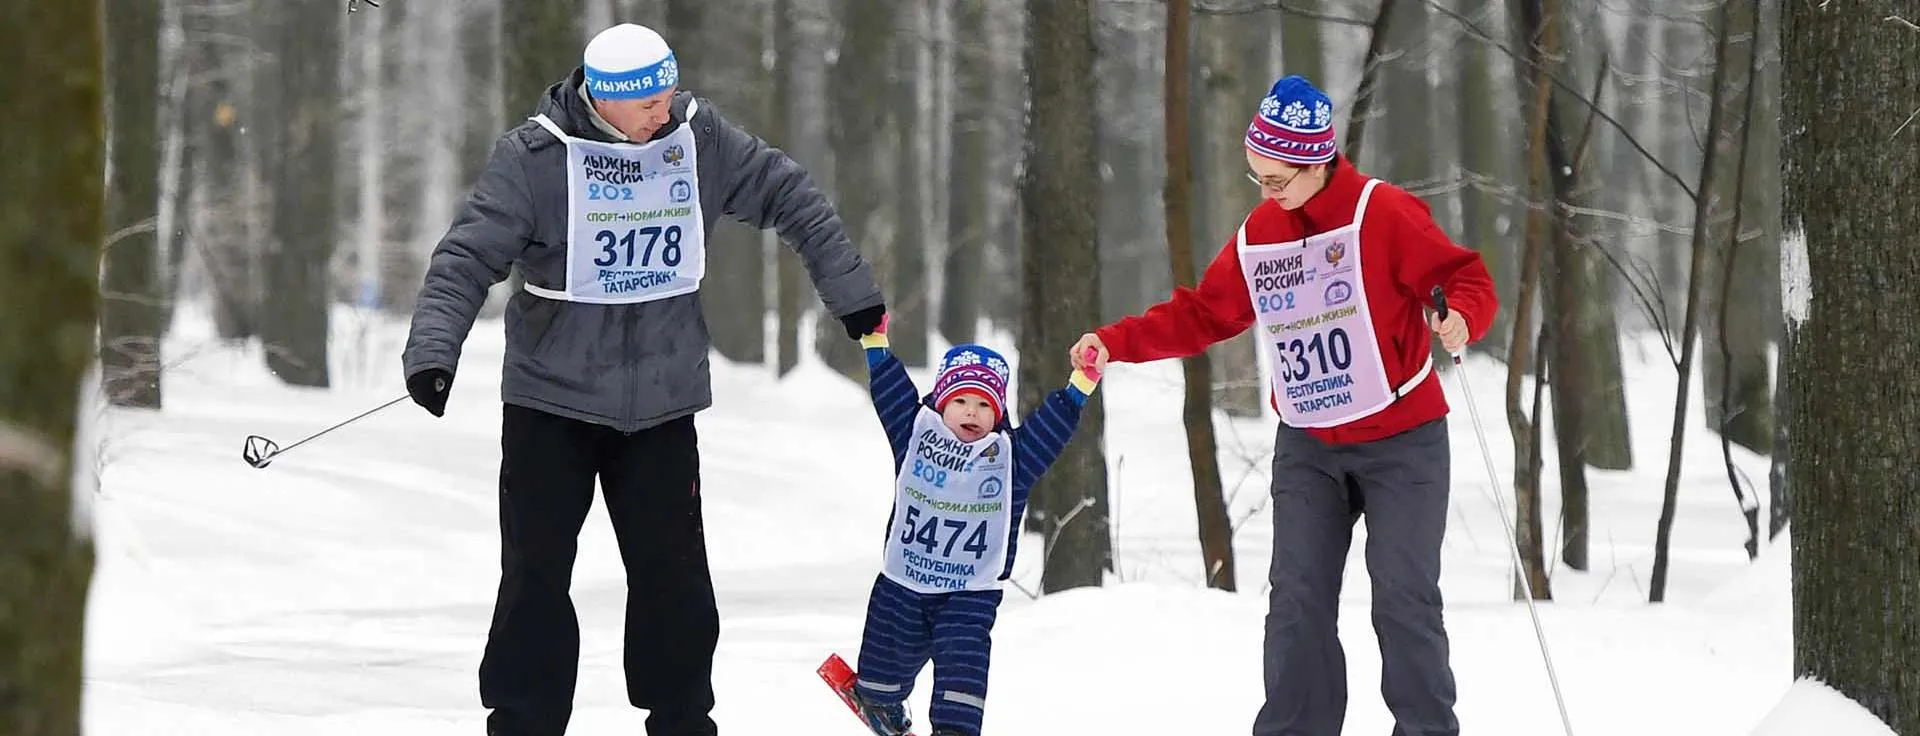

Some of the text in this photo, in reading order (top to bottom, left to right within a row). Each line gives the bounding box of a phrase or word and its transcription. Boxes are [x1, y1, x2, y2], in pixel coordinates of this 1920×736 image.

[594, 76, 653, 92] ЛЫЖНЯ
[583, 155, 641, 173] ЛЫЖНЯ
[586, 167, 644, 184] РОССИИ
[588, 183, 634, 200] 202
[586, 212, 618, 222] СПОРТ
[626, 210, 662, 222] НОРМА
[594, 225, 682, 267] 3178
[1254, 255, 1303, 277] ЛЫЖНЯ
[1255, 270, 1305, 292] РОССИИ
[1258, 291, 1296, 313] 202
[1267, 305, 1358, 334] ОРТ НОРМА ЖИЗНИ
[1276, 327, 1352, 383] 5310
[1286, 373, 1354, 399] РЕСПУБЛИКА
[1293, 391, 1353, 414] ТАТАРСТАН
[921, 429, 974, 458] ЛЫЖНЯ
[917, 442, 966, 472] РОССИИ
[912, 459, 947, 488] 202
[931, 499, 968, 512] НОРМА
[968, 501, 1002, 513] ЖИЗНИ
[901, 505, 988, 560] 5474
[903, 549, 975, 576] РЕСПУБЛИКА
[905, 565, 968, 589] ТАТАРСТАН
